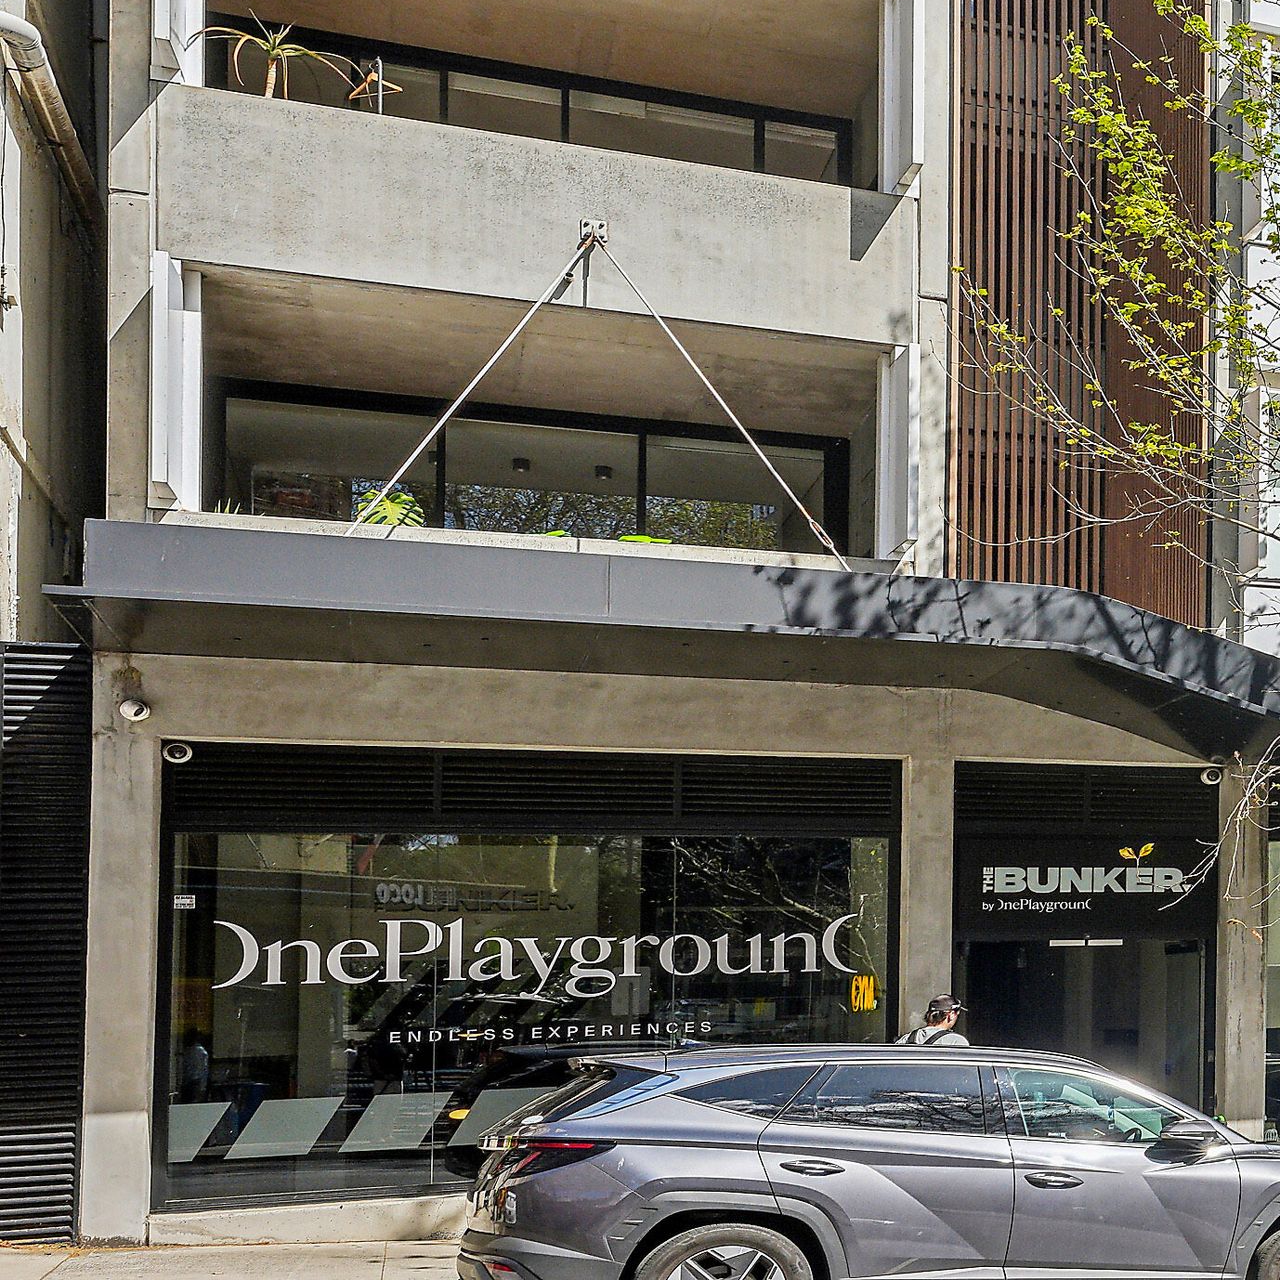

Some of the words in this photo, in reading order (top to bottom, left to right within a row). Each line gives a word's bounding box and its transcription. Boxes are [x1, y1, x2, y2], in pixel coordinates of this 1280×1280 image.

[982, 867, 993, 893] THE
[994, 867, 1184, 894] BUNKER
[982, 902, 995, 911] by
[390, 1029, 514, 1043] ENDLESS
[531, 1021, 712, 1039] EXPERIENCES
